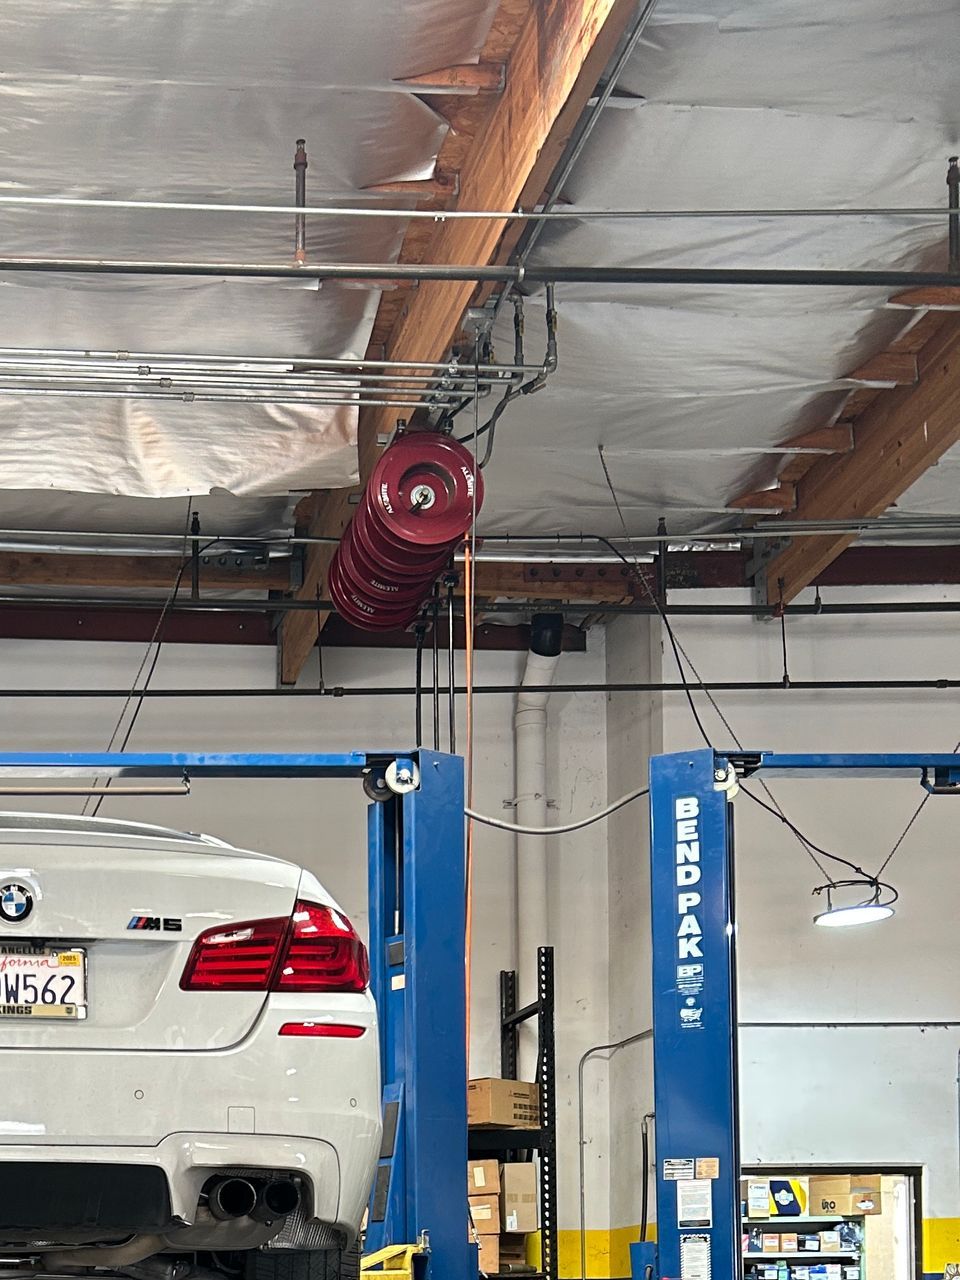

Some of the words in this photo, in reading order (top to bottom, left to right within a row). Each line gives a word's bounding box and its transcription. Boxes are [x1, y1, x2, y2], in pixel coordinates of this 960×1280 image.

[381, 482, 394, 514] ALEMITE
[460, 466, 474, 498] ALEMITE
[675, 797, 701, 887] BEND
[140, 916, 182, 931] M5
[677, 892, 703, 959] PAK
[1, 946, 45, 954] ANGELES
[679, 965, 702, 978] BP
